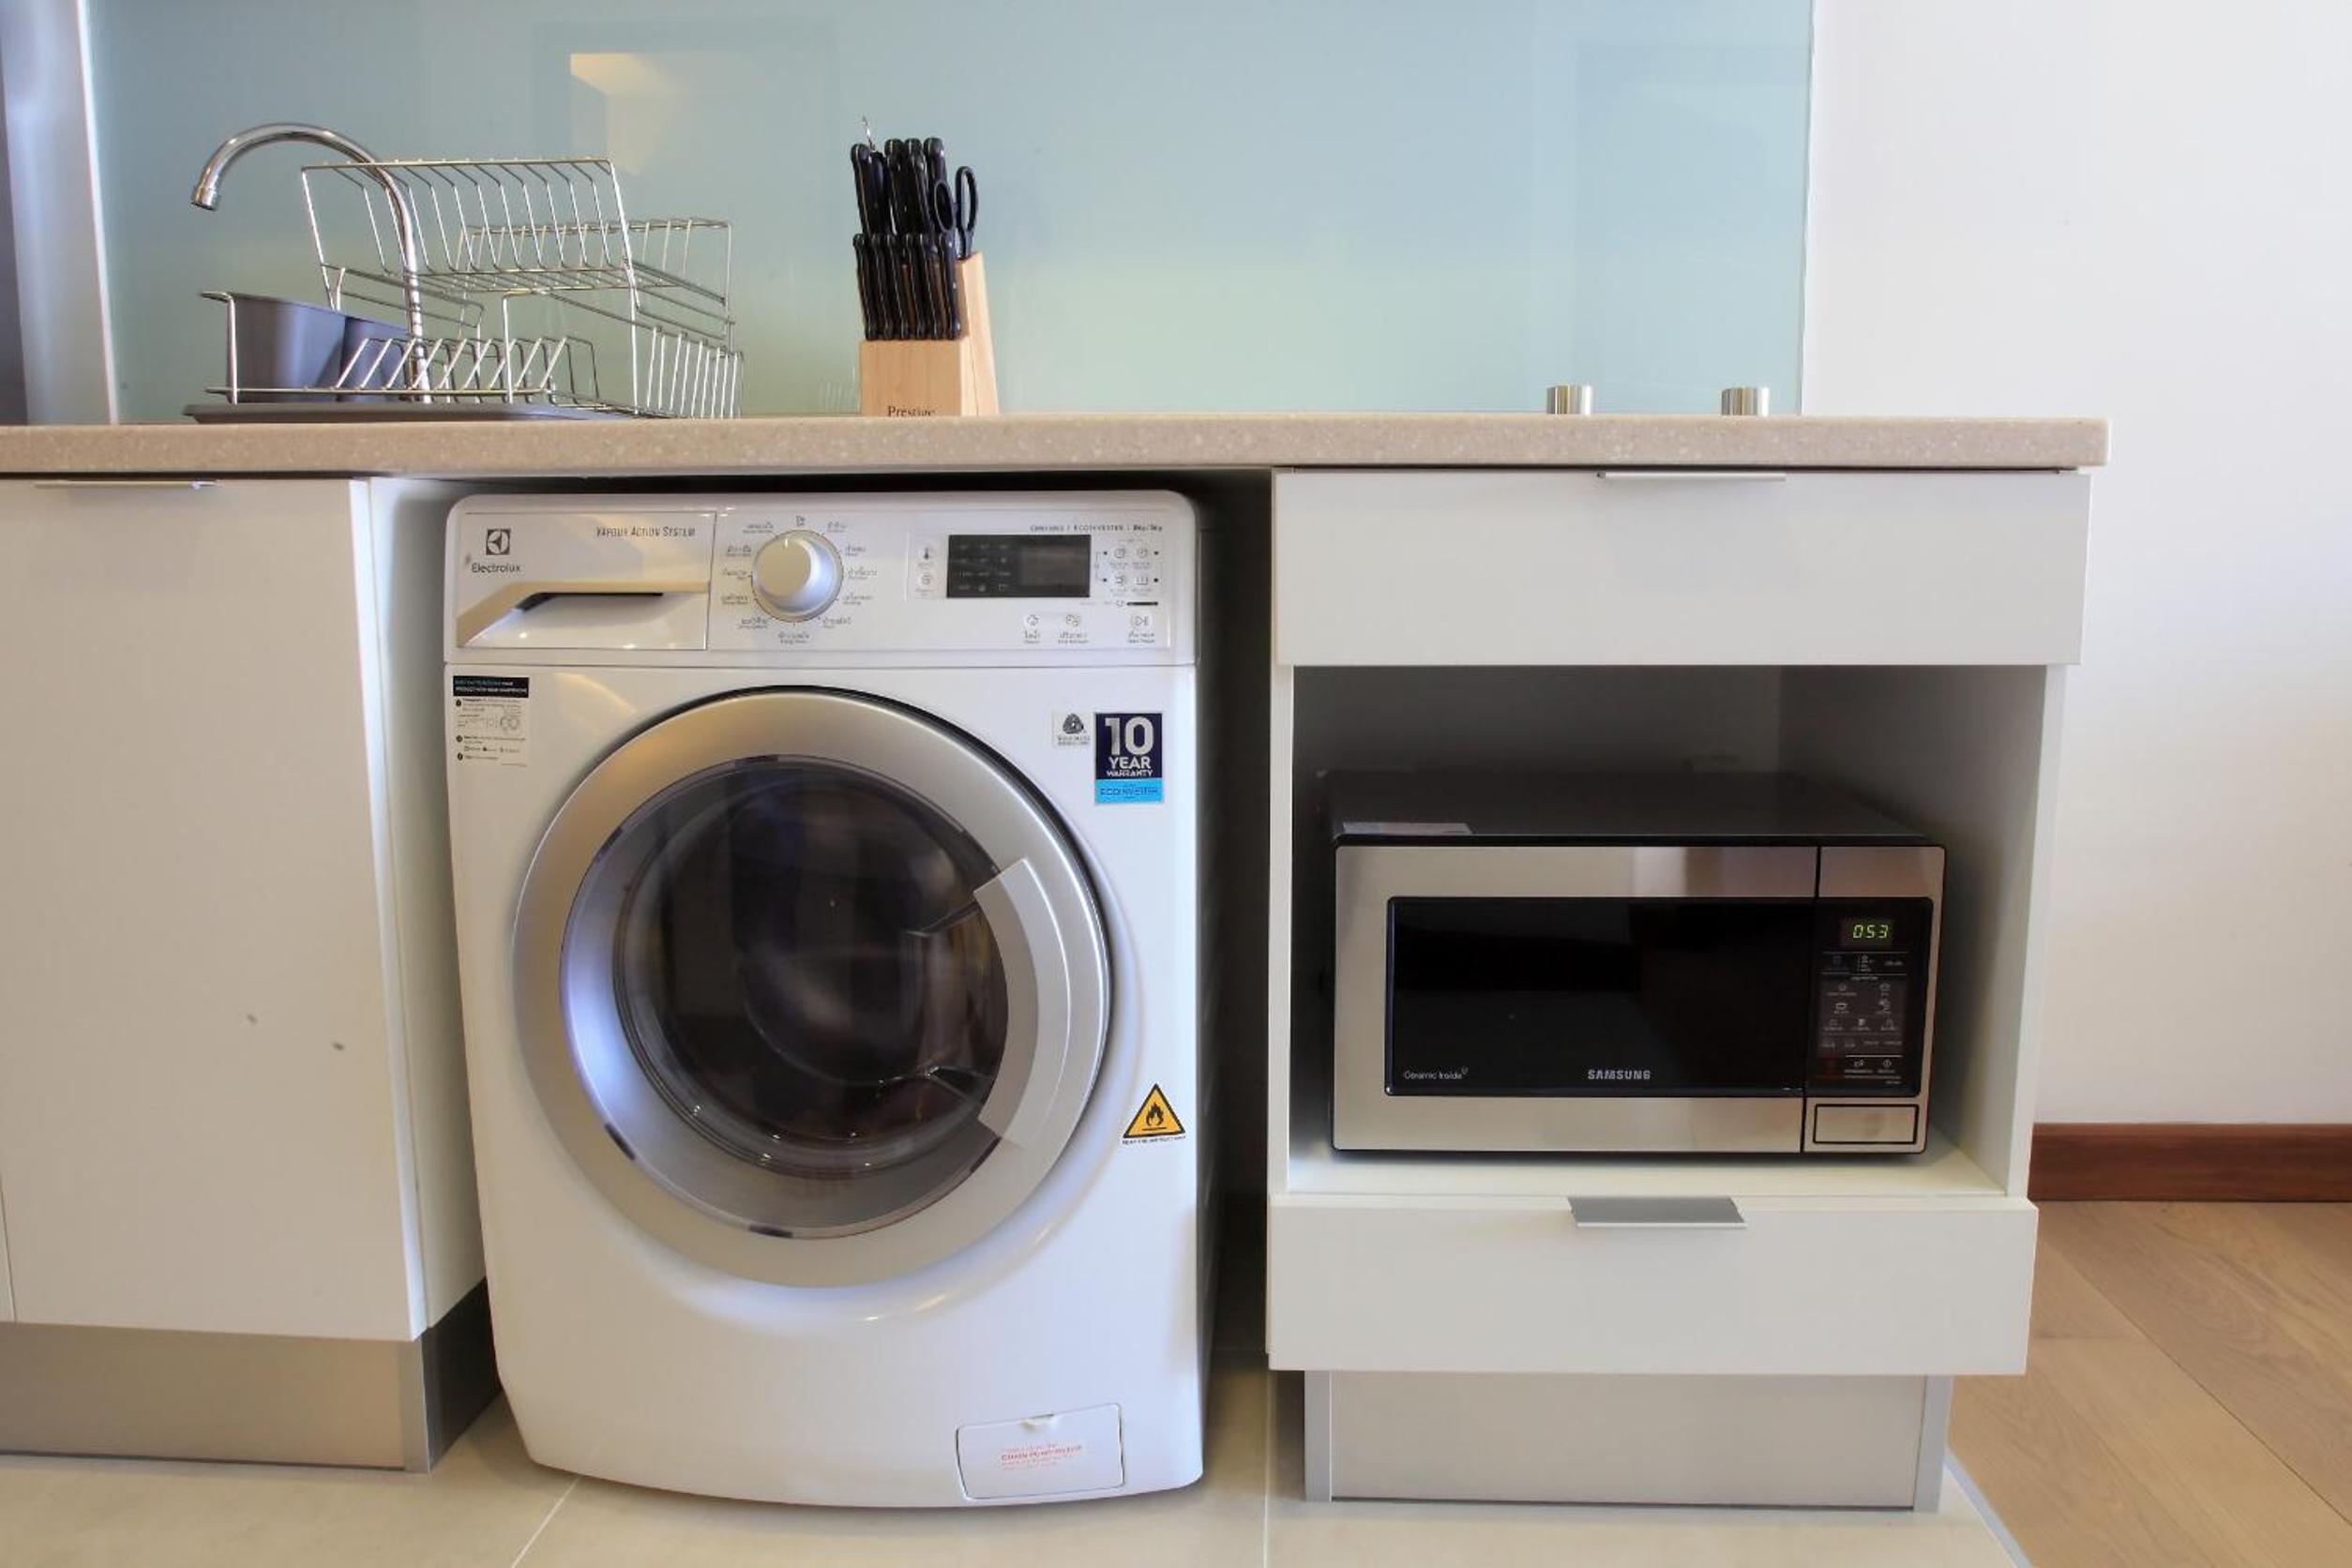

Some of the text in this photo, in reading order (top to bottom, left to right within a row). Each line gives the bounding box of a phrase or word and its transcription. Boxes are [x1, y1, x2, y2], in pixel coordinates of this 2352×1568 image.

[472, 563, 521, 573] Electrolux
[1105, 716, 1153, 756] 10
[1108, 756, 1152, 769] YEAR
[1106, 769, 1153, 777] WARRANTY
[1587, 1069, 1651, 1080] SAMSUNG
